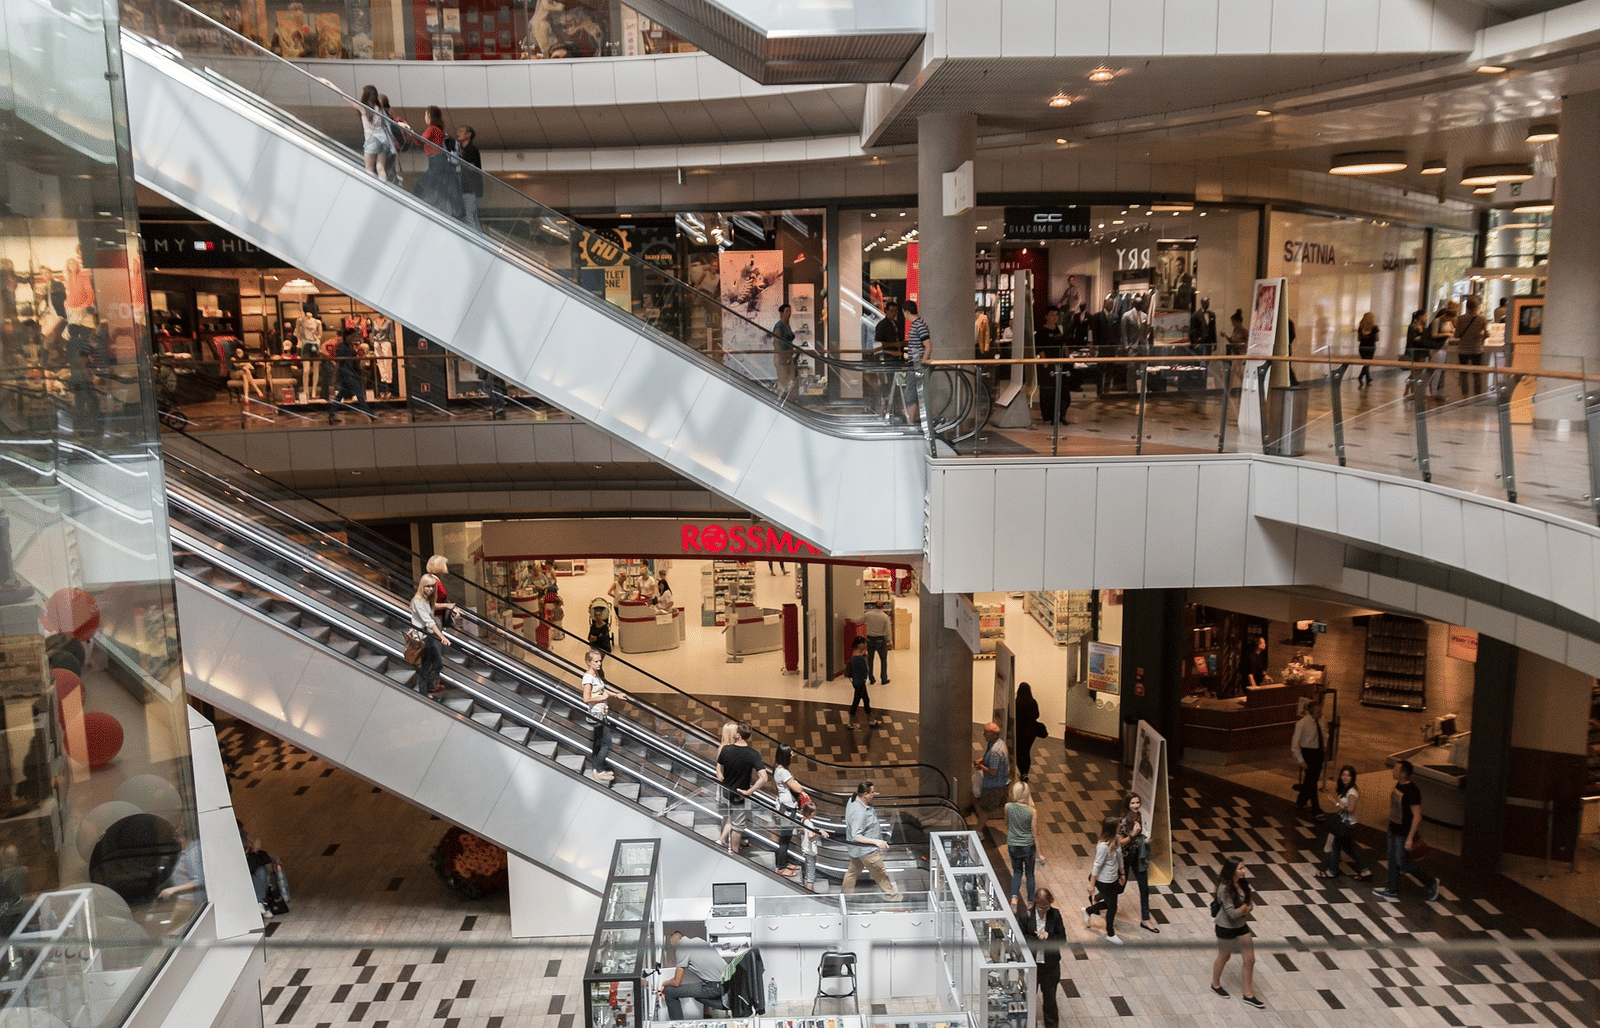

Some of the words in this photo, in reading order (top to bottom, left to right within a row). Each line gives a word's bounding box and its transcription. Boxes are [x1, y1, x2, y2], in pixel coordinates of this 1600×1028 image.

[1009, 224, 1053, 233] GIACOMO
[1059, 224, 1087, 232] CONTI
[222, 239, 260, 252] HIL
[1284, 240, 1336, 265] SZATNIA
[681, 524, 822, 554] ROSSMA
